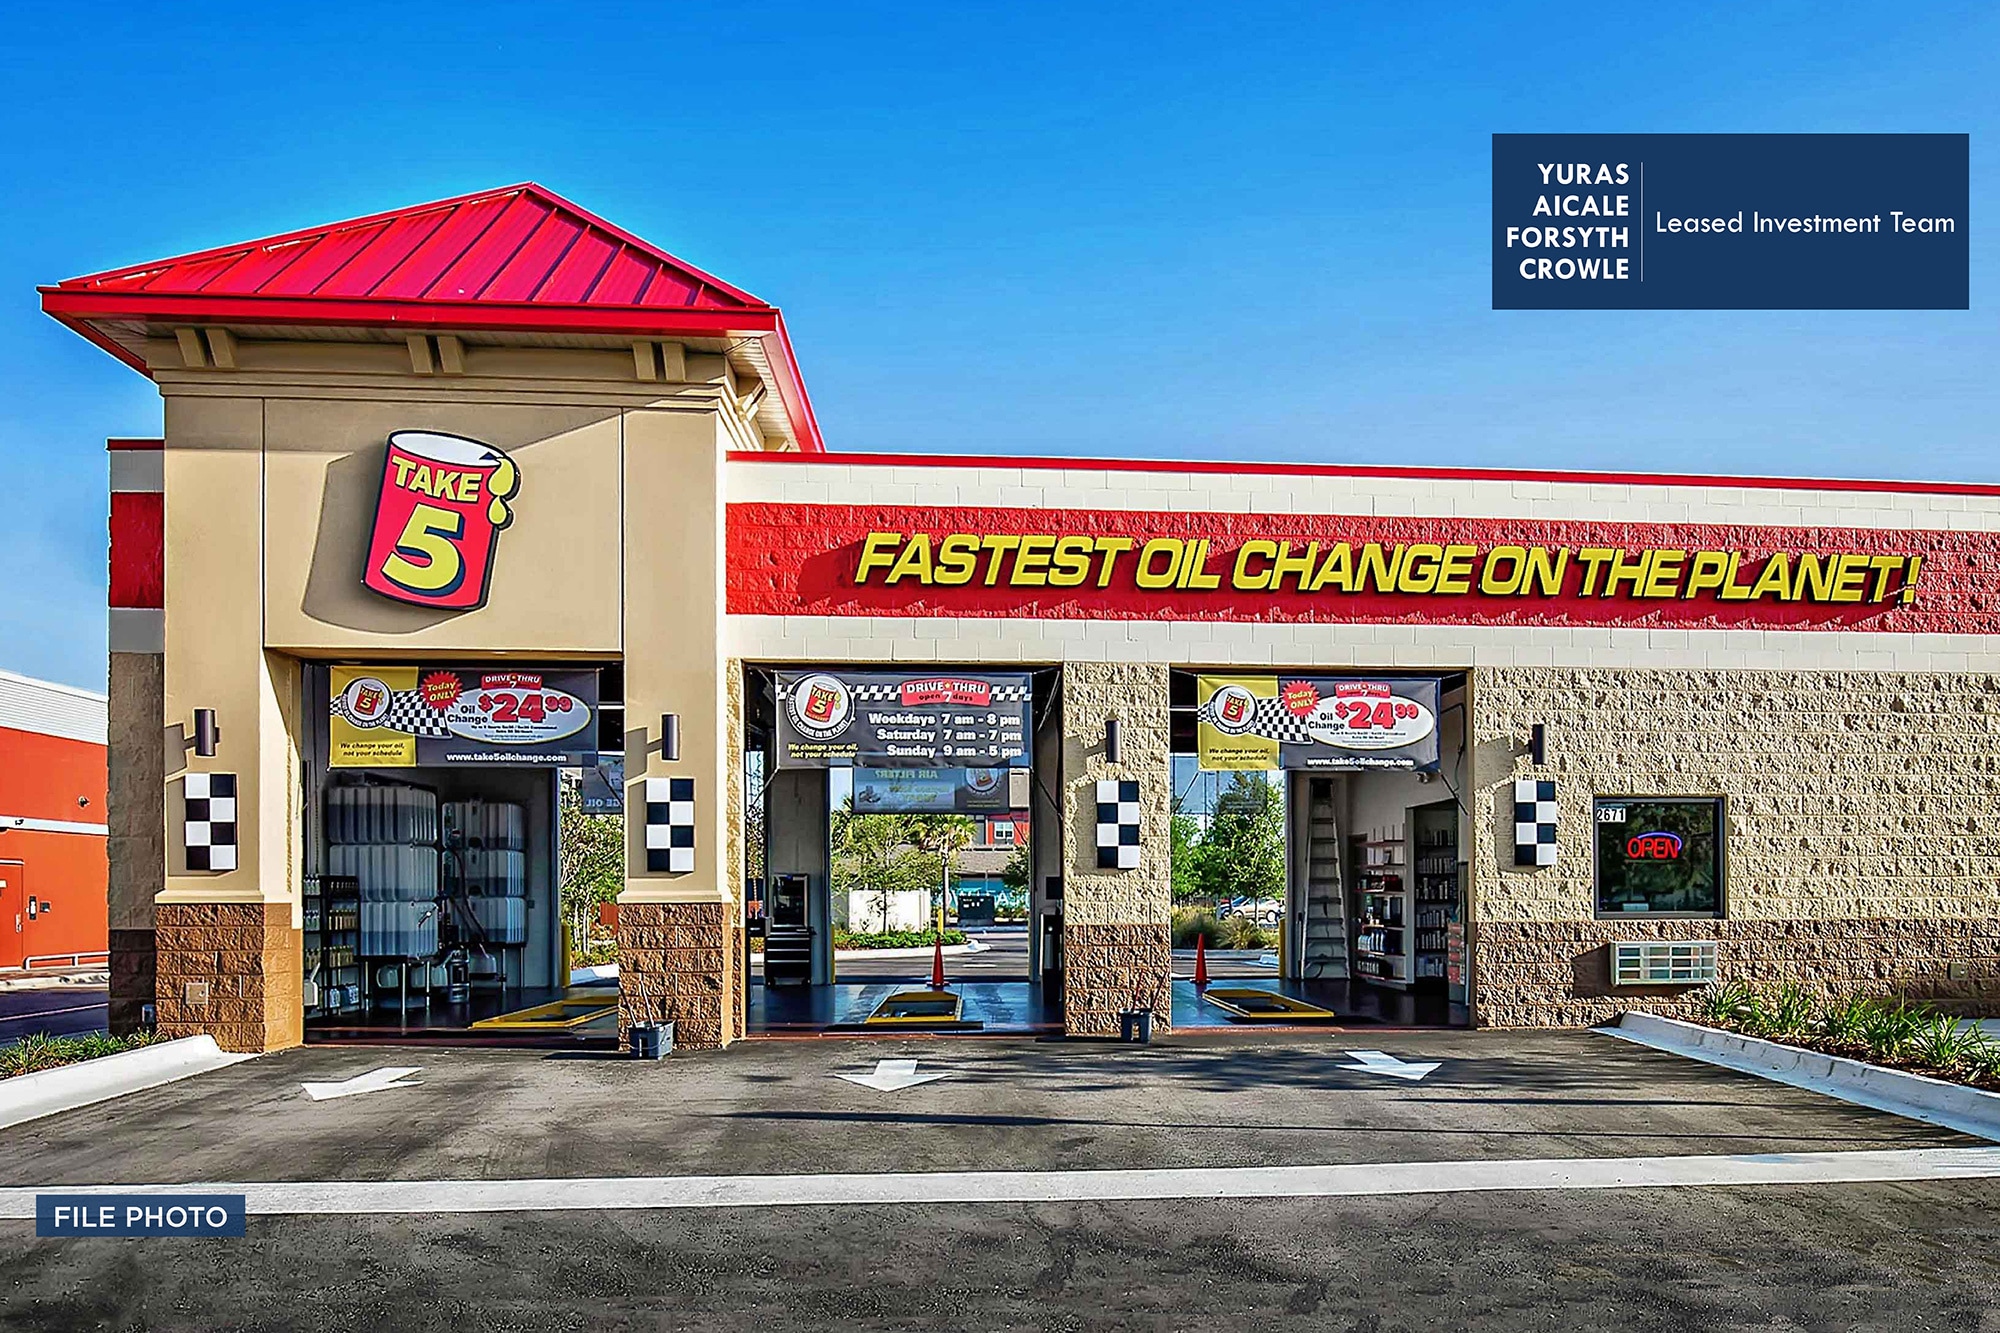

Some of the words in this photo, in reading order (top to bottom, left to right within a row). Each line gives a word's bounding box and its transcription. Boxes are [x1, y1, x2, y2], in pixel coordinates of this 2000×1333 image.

[392, 455, 483, 502] TAKE
[381, 503, 460, 590] 5
[854, 532, 1131, 586] FASTEST
[1135, 538, 1223, 589] OIL
[1232, 541, 1477, 594] CHANGE
[1483, 546, 1569, 596] ON
[1577, 548, 1687, 597] THE
[1686, 551, 1923, 603] PLANET!
[485, 675, 510, 683] DRIVE
[517, 675, 540, 684] THRU
[427, 682, 456, 691] Today
[906, 682, 944, 693] DRIVE
[953, 682, 986, 694] THRU
[1339, 683, 1361, 691] DRIVE
[1368, 683, 1388, 692] THRU
[430, 690, 456, 702] ONLY
[811, 687, 834, 702] TAKE
[942, 691, 952, 703] 7
[953, 693, 973, 701] days
[1287, 690, 1314, 699] Today
[360, 697, 372, 708] 5
[811, 700, 826, 714] 5
[1290, 698, 1314, 709] ONLY
[460, 705, 475, 713] Oil
[1227, 705, 1239, 716] 5
[447, 714, 488, 724] Change
[868, 713, 936, 727] Weekdays
[941, 713, 951, 724] 7
[954, 715, 975, 724] am
[986, 713, 997, 724] 8
[1000, 716, 1020, 727] pm
[1320, 712, 1333, 720] Oil
[1308, 721, 1345, 731] Change
[876, 728, 936, 743] Saturday
[943, 729, 953, 740] 7
[955, 731, 977, 740] am
[988, 729, 998, 740] 7
[1001, 732, 1022, 743] pm
[828, 744, 845, 752] your
[886, 744, 936, 759] Sunday
[942, 744, 953, 756] 9
[955, 747, 977, 756] am
[988, 745, 998, 756] 5
[1001, 747, 1022, 758] pm
[446, 753, 567, 762] www.take5oilchange.com
[1307, 757, 1414, 767] www.take5oilchange.com
[1597, 808, 1625, 821] 2671
[1627, 837, 1679, 860] OPEN
